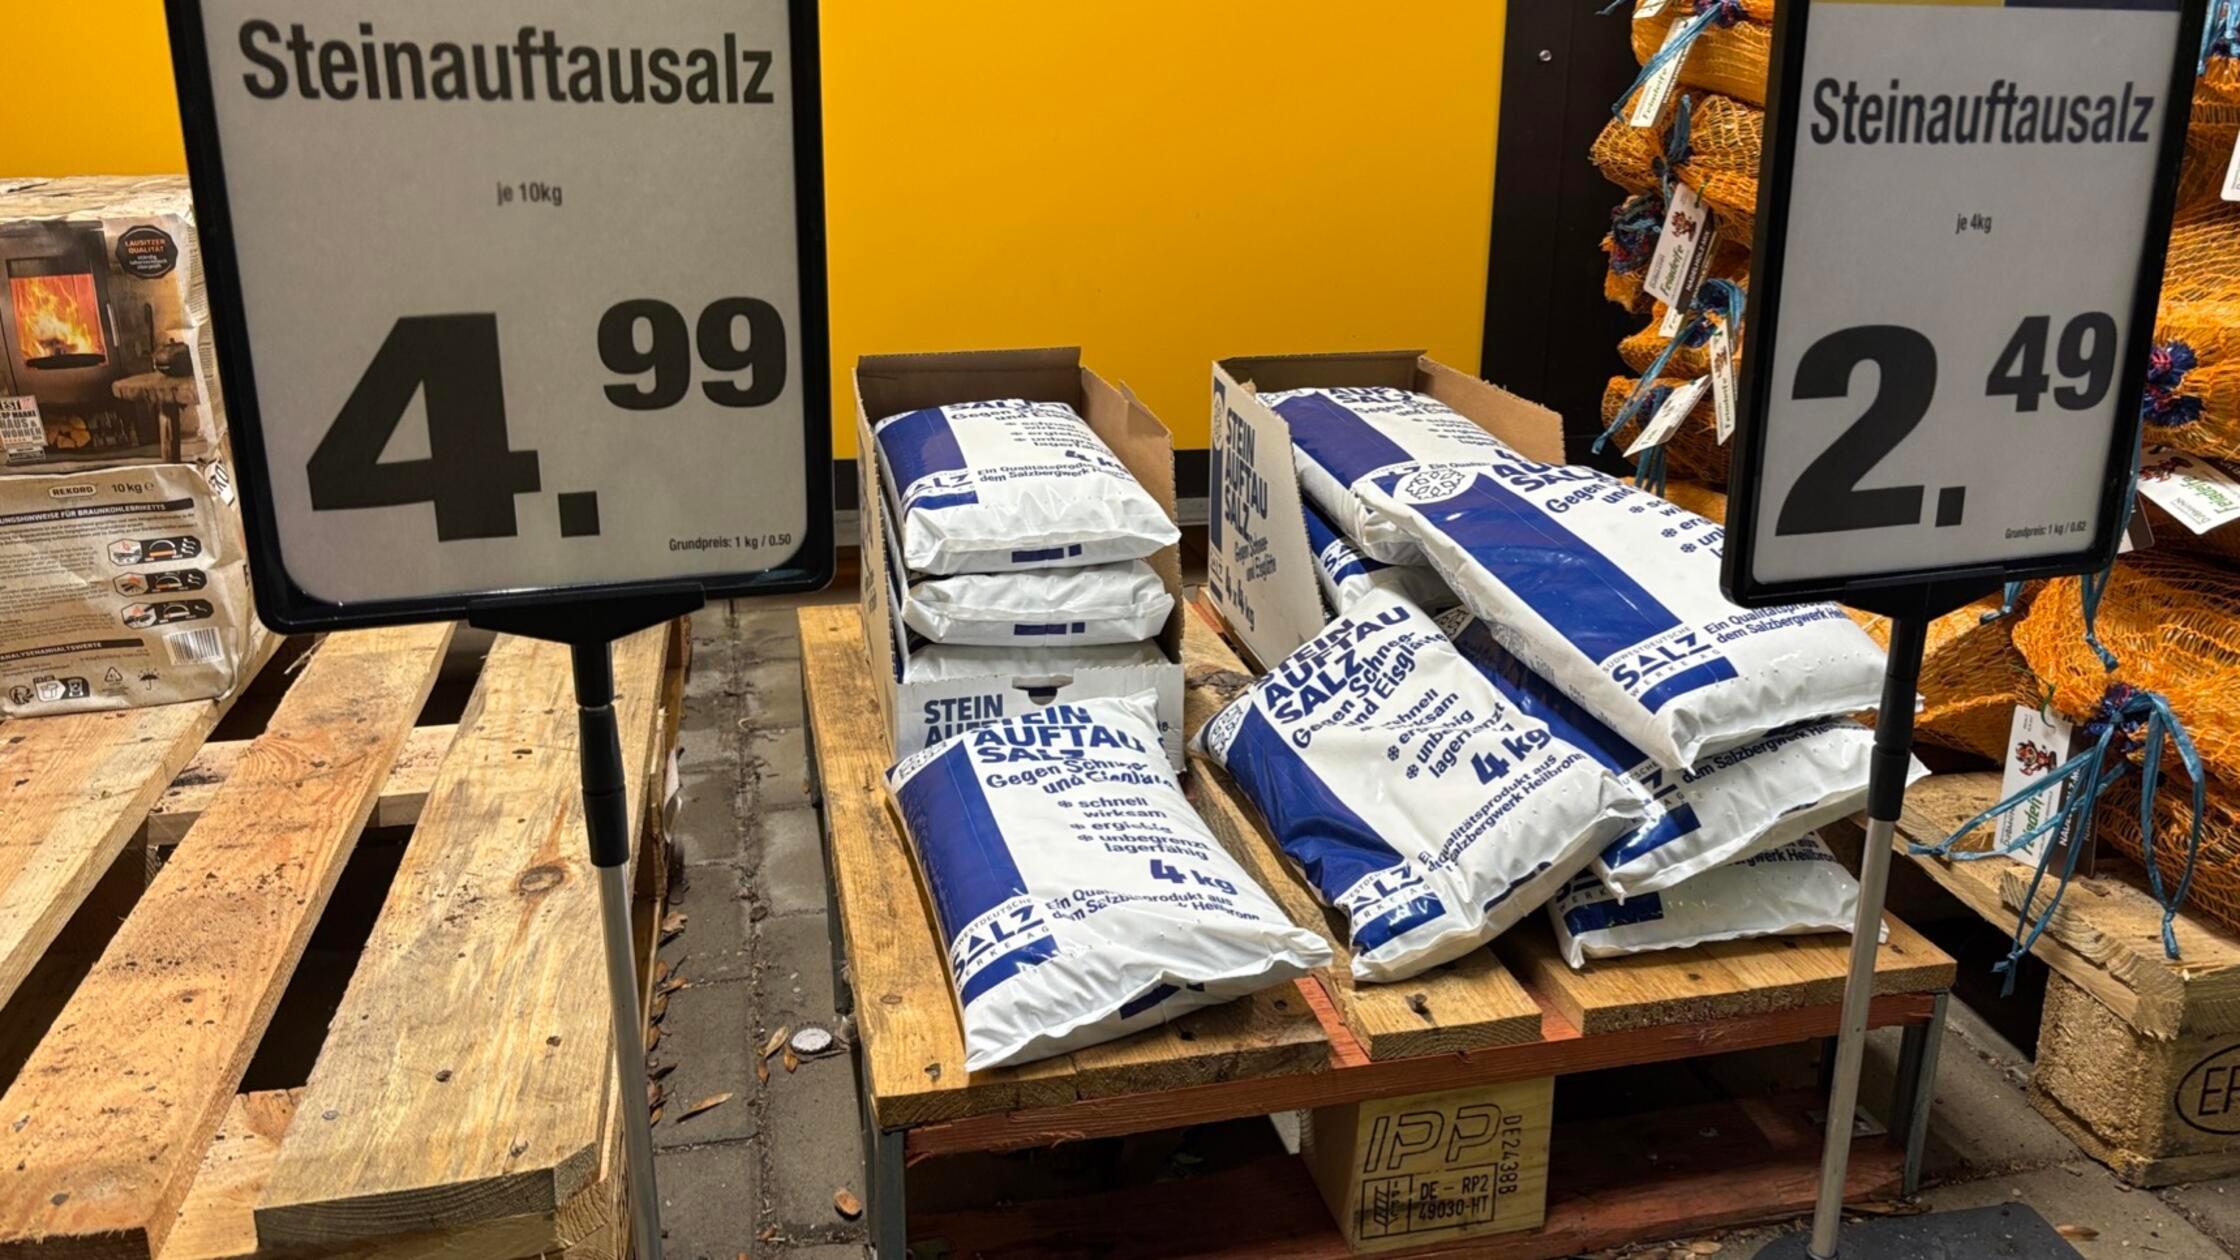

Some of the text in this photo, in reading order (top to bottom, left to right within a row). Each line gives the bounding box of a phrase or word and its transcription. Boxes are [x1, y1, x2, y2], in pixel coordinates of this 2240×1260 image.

[238, 18, 775, 104] Steinauftausalz
[1810, 77, 2156, 145] Steinauftausalz
[497, 182, 563, 207] je 10kg
[1955, 213, 1992, 234] je 4kg
[1226, 407, 1256, 467] STEIN
[52, 485, 94, 497] REKORD
[111, 483, 143, 496] 10 kg
[979, 474, 1007, 482] dem
[1225, 449, 1269, 520] AUFTAU
[1224, 485, 1251, 541] SALZ
[1545, 483, 1606, 514] Gegen
[669, 536, 733, 551] Grundpreis:
[734, 536, 742, 548] 1
[744, 535, 759, 550] kg
[769, 533, 792, 547] 0.50
[2005, 527, 2047, 540] Grundpreis:
[2055, 523, 2065, 536] kg
[1704, 619, 1728, 634] Ein
[1716, 627, 1747, 645] dem
[1749, 610, 1827, 635] Salzbergwerk
[1264, 606, 1410, 712] AUFTAU
[1602, 625, 1692, 673] SÜDWESTDEUTSCHE
[1612, 632, 1712, 691] SALZ
[1274, 649, 1364, 725] SALZ
[1631, 650, 1721, 698] WERKE AG
[924, 694, 1004, 724] STEIN
[974, 725, 1146, 754] AUFTAU
[1714, 730, 1809, 770] Salzbergwerk
[977, 746, 1086, 763] SALZ
[1470, 728, 1552, 785] 4 kg
[1533, 753, 1557, 775] aus
[986, 765, 1062, 788] Gegen
[1042, 773, 1085, 794] und
[1078, 796, 1149, 808] schnell
[1083, 809, 1167, 819] wirksam
[1099, 834, 1208, 851] unbegrenzt
[1104, 842, 1209, 861] lagerfähig
[1150, 859, 1239, 895] 4 kg
[953, 905, 1044, 985] SALZ
[1363, 1103, 1503, 1174] IPP
[1420, 1180, 1439, 1201] DE
[1462, 1174, 1489, 1195] RP2
[1418, 1195, 1489, 1221] 49030-HT
